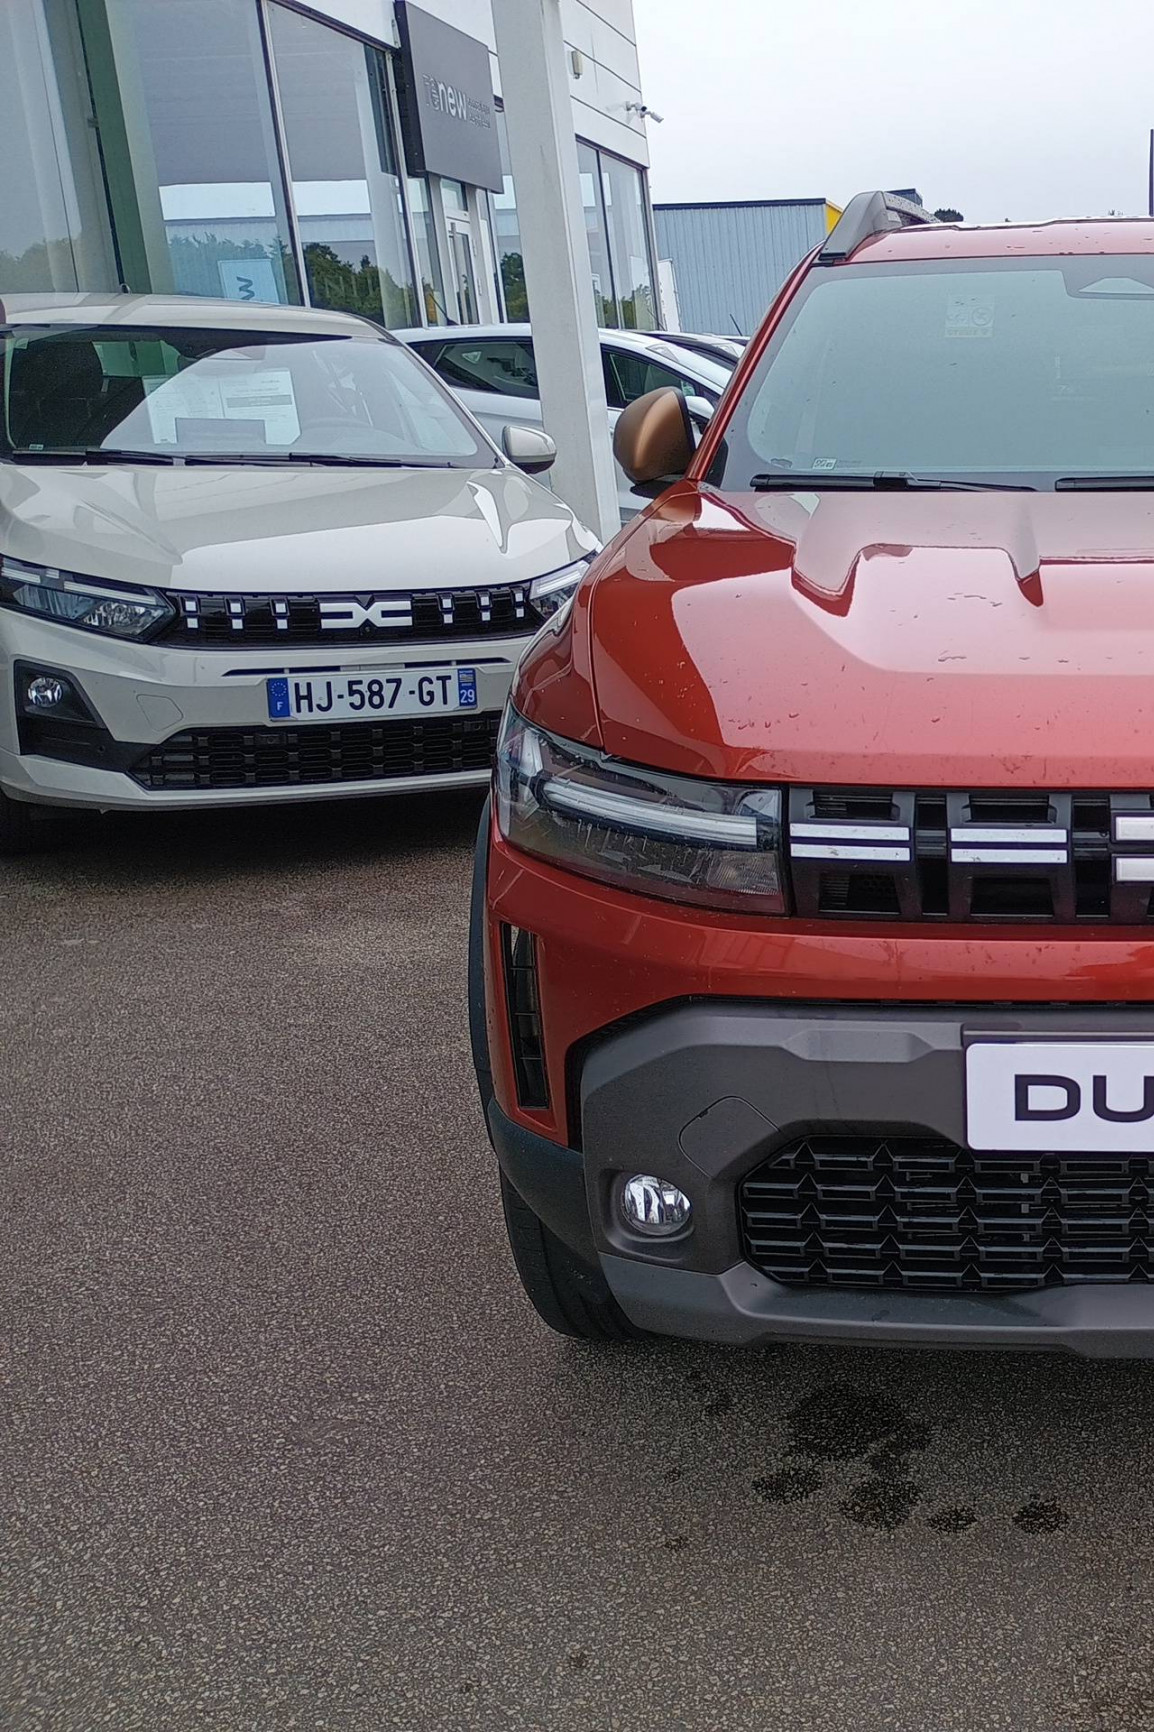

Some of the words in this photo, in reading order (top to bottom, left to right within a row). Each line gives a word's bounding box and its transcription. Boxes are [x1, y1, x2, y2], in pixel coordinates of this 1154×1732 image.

[277, 701, 284, 711] F
[294, 675, 452, 713] HJ-587-GT
[459, 689, 475, 704] 29
